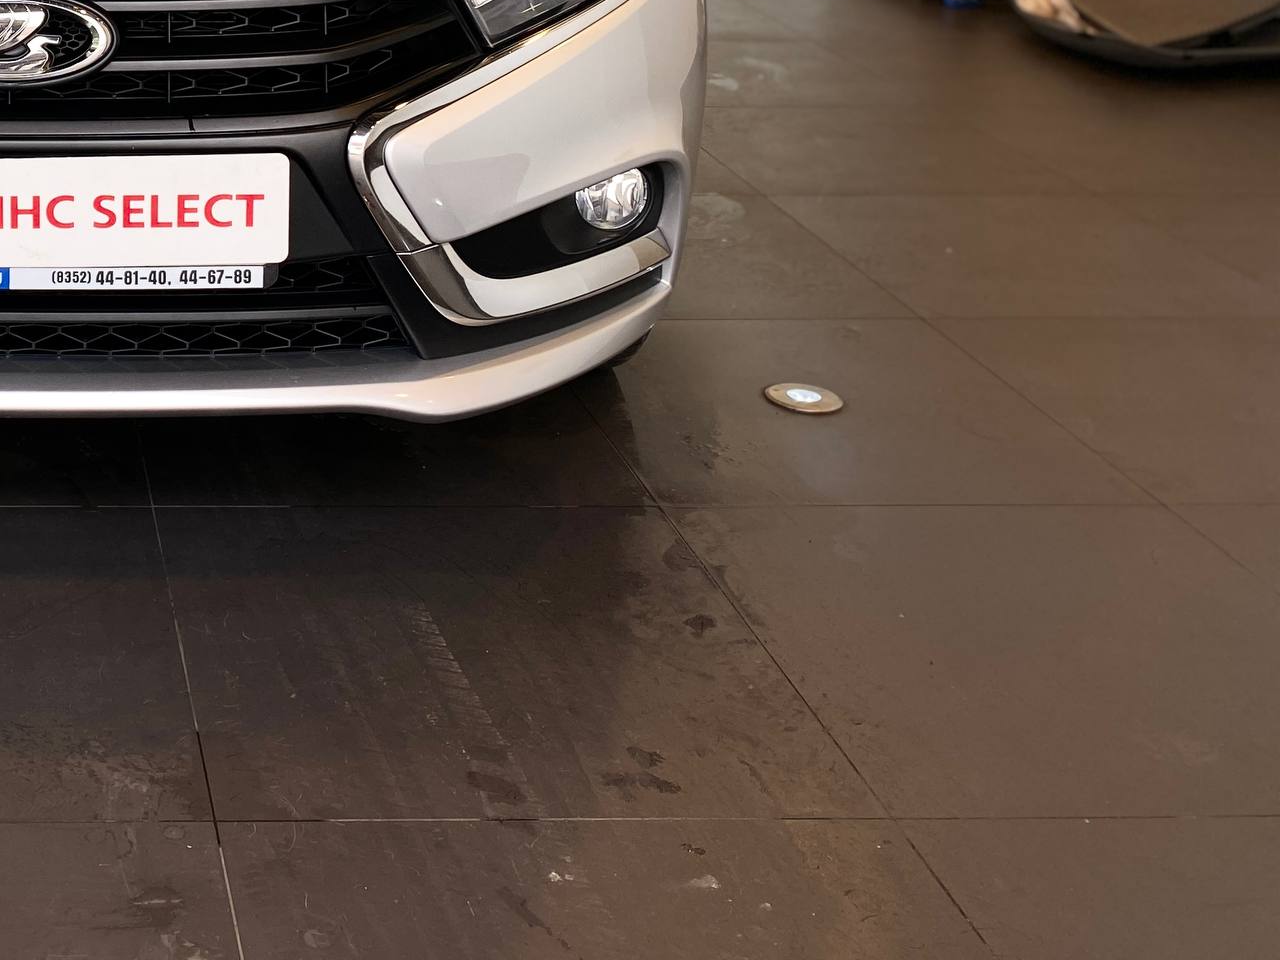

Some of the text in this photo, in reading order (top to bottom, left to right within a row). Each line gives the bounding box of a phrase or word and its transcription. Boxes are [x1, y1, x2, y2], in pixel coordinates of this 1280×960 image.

[92, 193, 265, 229] SELECT
[51, 269, 252, 287] (8352) 44-81-40, 44-67-89
